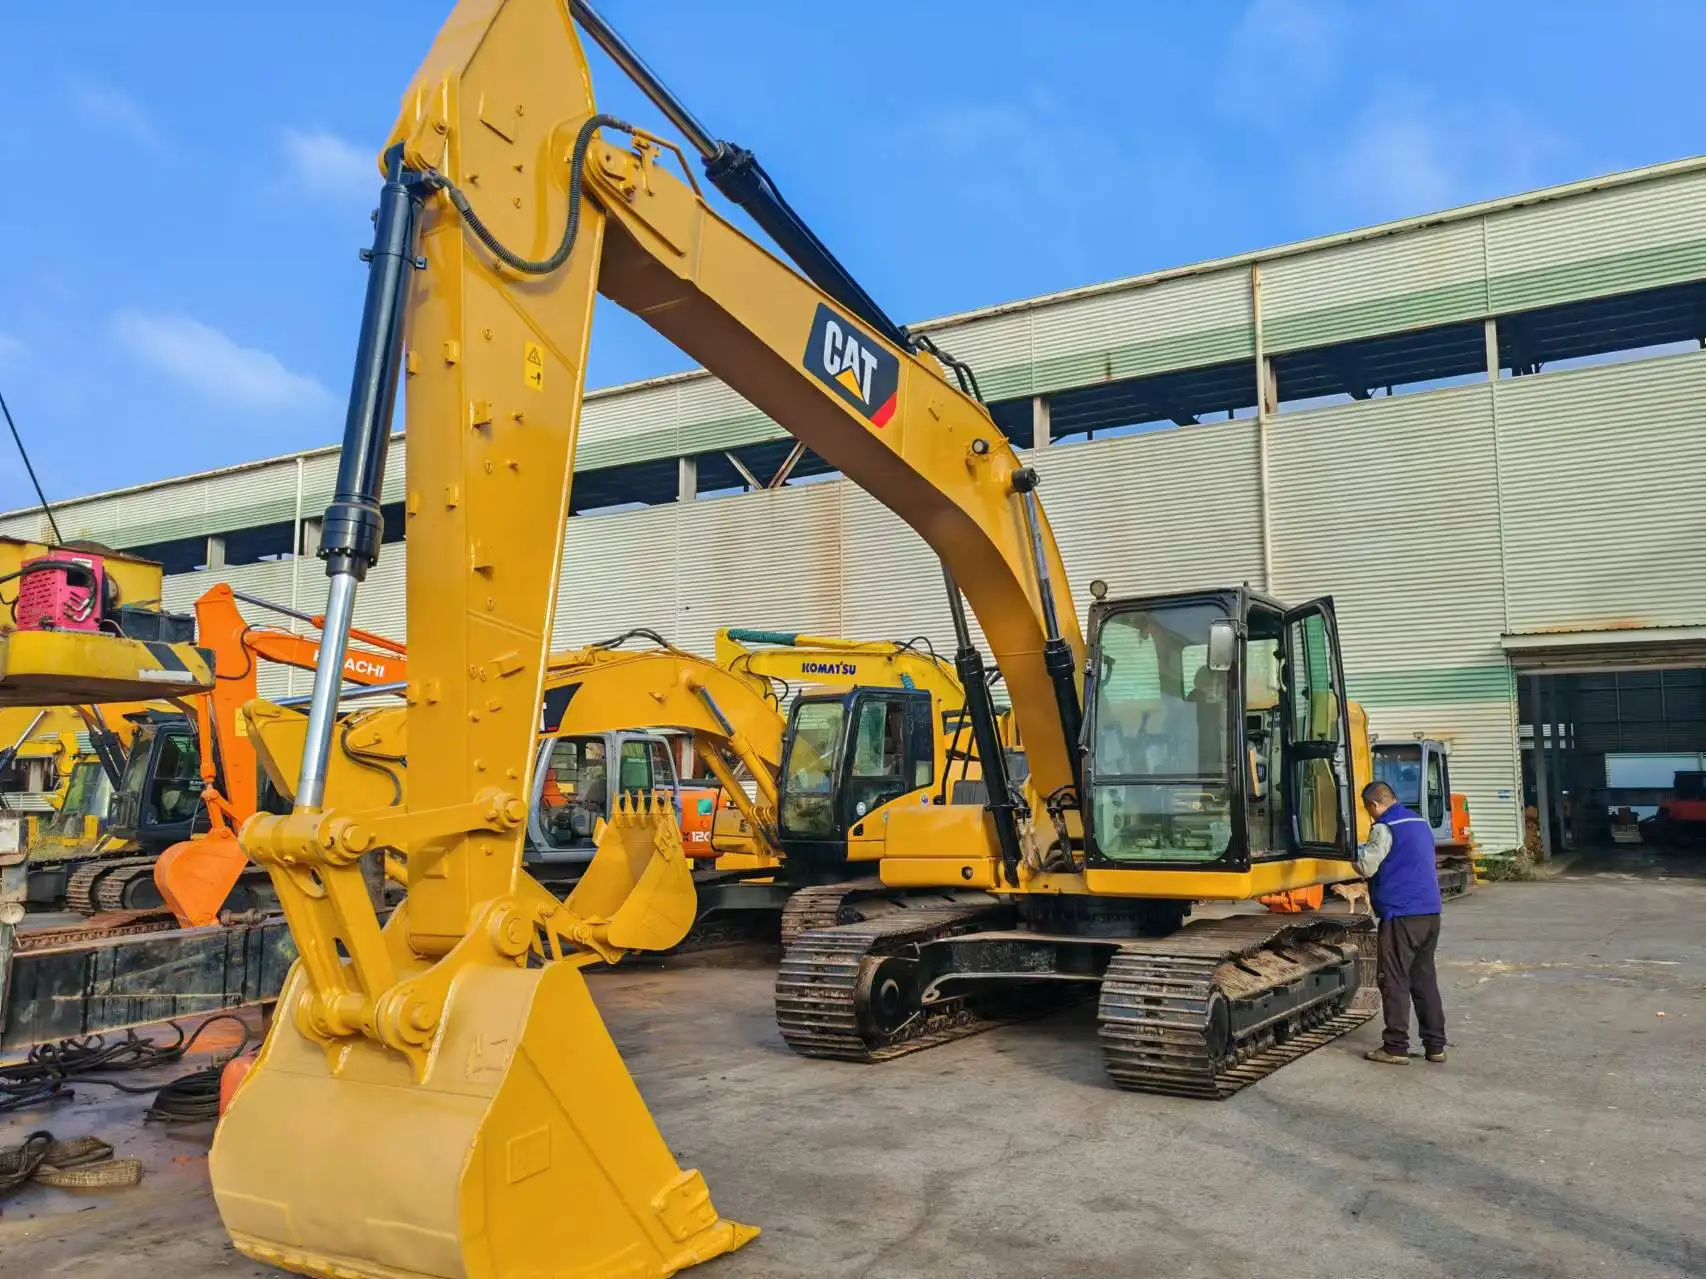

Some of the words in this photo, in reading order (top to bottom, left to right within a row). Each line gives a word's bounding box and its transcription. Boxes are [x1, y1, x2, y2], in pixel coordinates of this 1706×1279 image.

[823, 320, 878, 406] CAT
[313, 649, 385, 678] ACHI
[801, 661, 857, 675] KOMATSU
